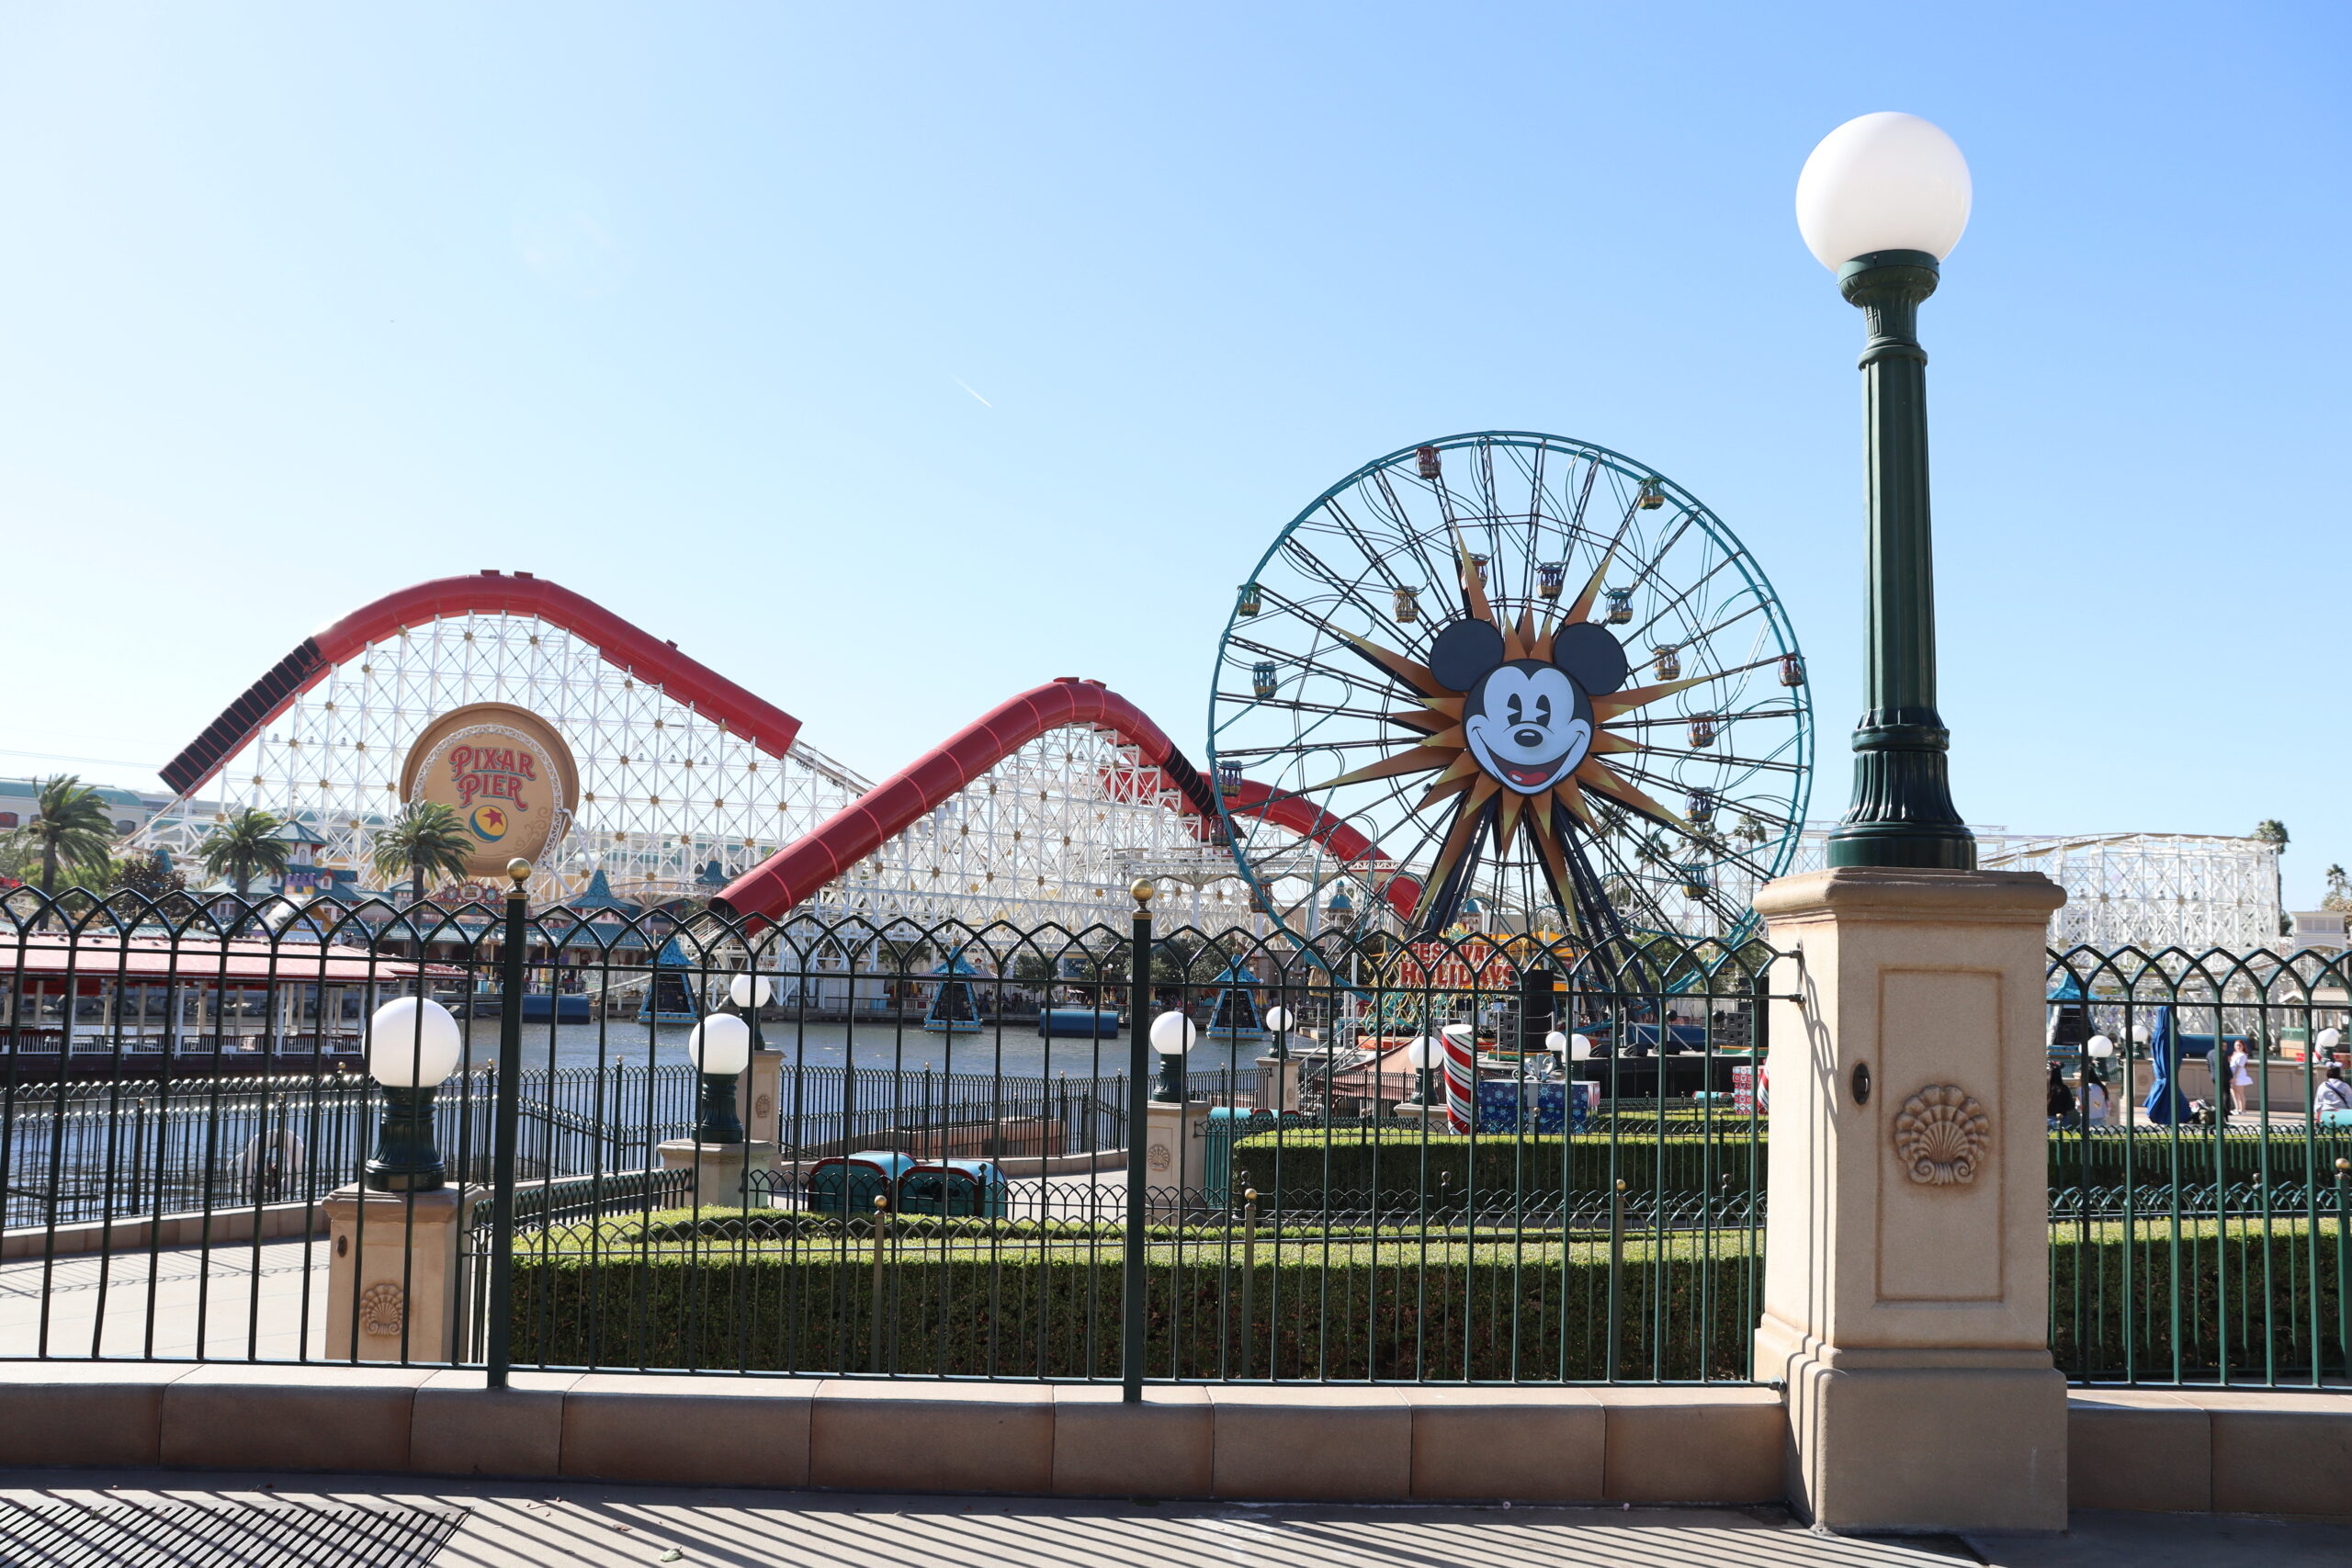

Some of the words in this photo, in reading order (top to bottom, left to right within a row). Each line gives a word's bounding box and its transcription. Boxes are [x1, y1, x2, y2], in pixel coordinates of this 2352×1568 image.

[449, 745, 536, 781] PIXAR
[458, 773, 528, 811] PIER
[1398, 962, 1514, 986] HOLIDAYS
